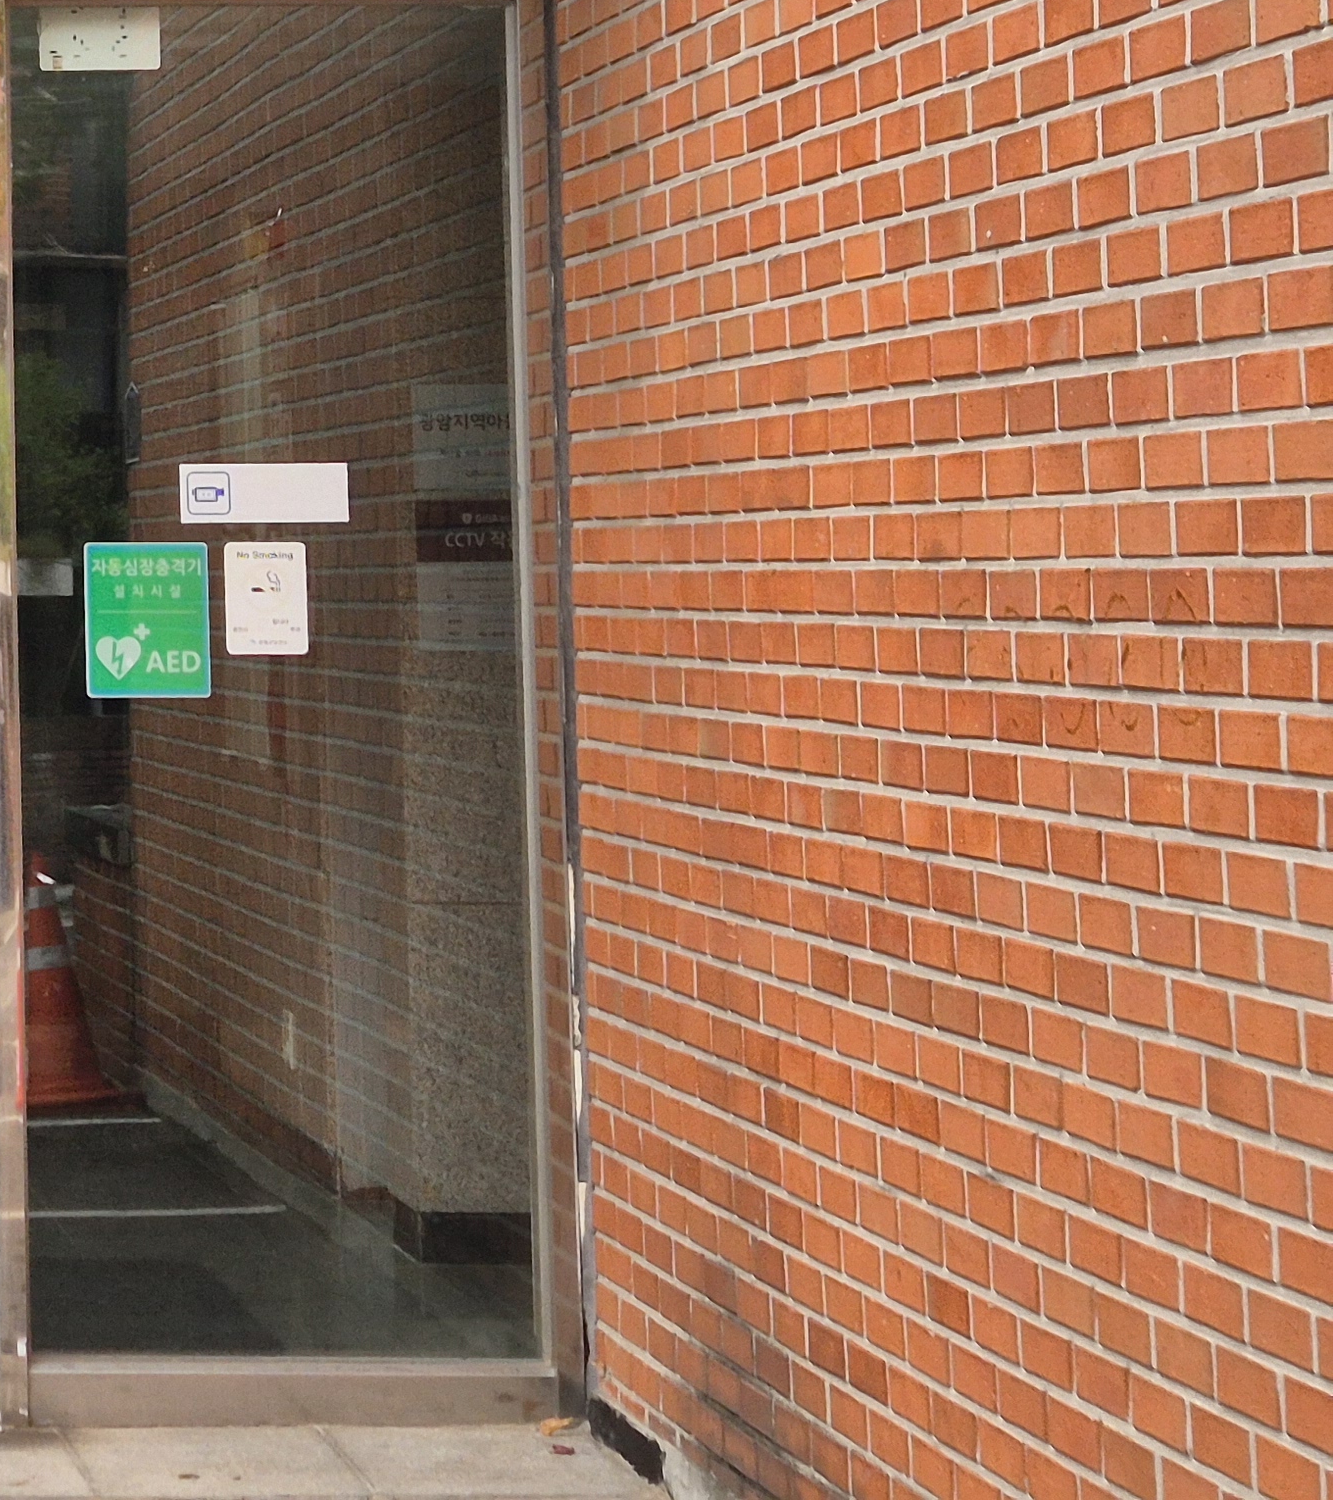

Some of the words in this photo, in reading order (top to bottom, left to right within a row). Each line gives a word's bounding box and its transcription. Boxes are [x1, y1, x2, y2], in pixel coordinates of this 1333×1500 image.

[444, 532, 485, 548] CCTV
[236, 551, 250, 560] No
[252, 551, 294, 562] Smoking
[91, 557, 202, 577] 자동심장충격기
[145, 650, 202, 674] AED
